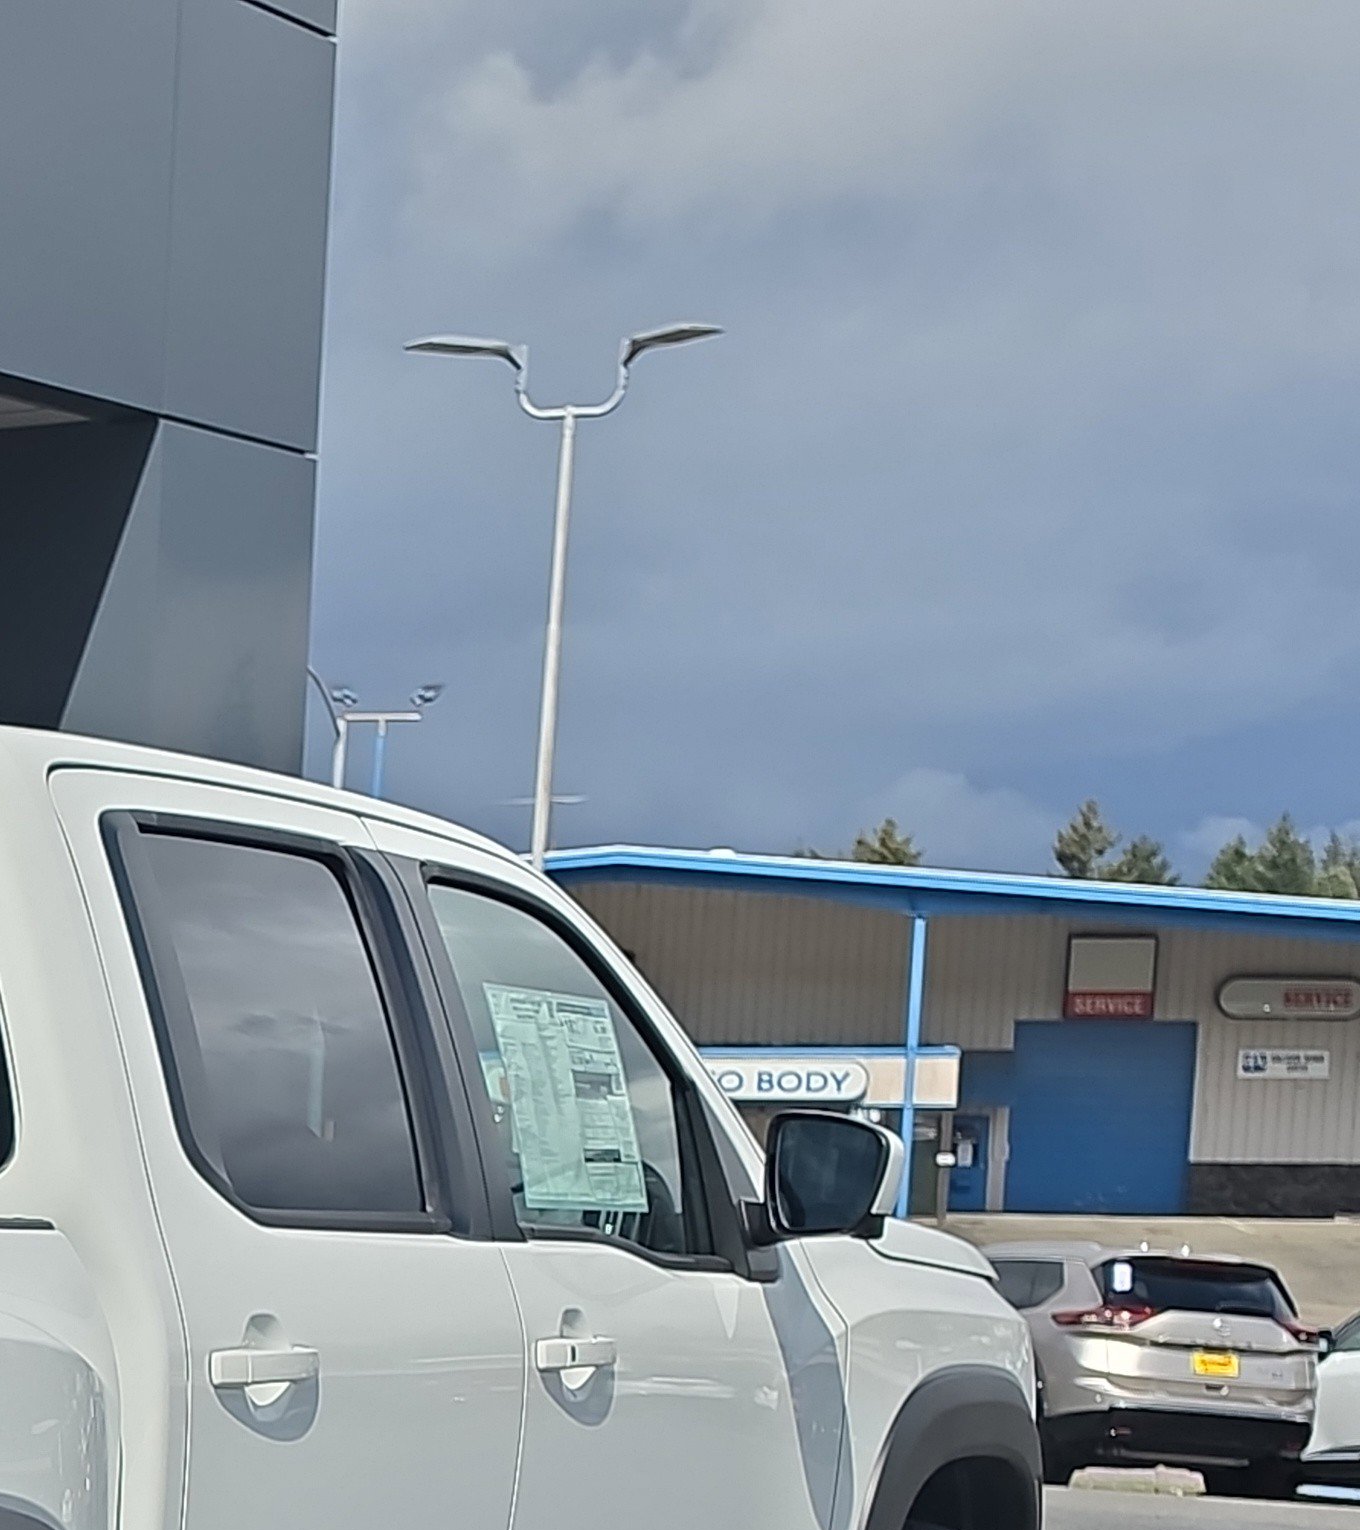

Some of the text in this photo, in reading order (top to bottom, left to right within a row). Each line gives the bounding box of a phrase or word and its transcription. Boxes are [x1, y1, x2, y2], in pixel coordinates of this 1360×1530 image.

[1073, 997, 1146, 1015] SERVICE
[1284, 988, 1354, 1008] SERVICE
[757, 1070, 851, 1093] BODY
